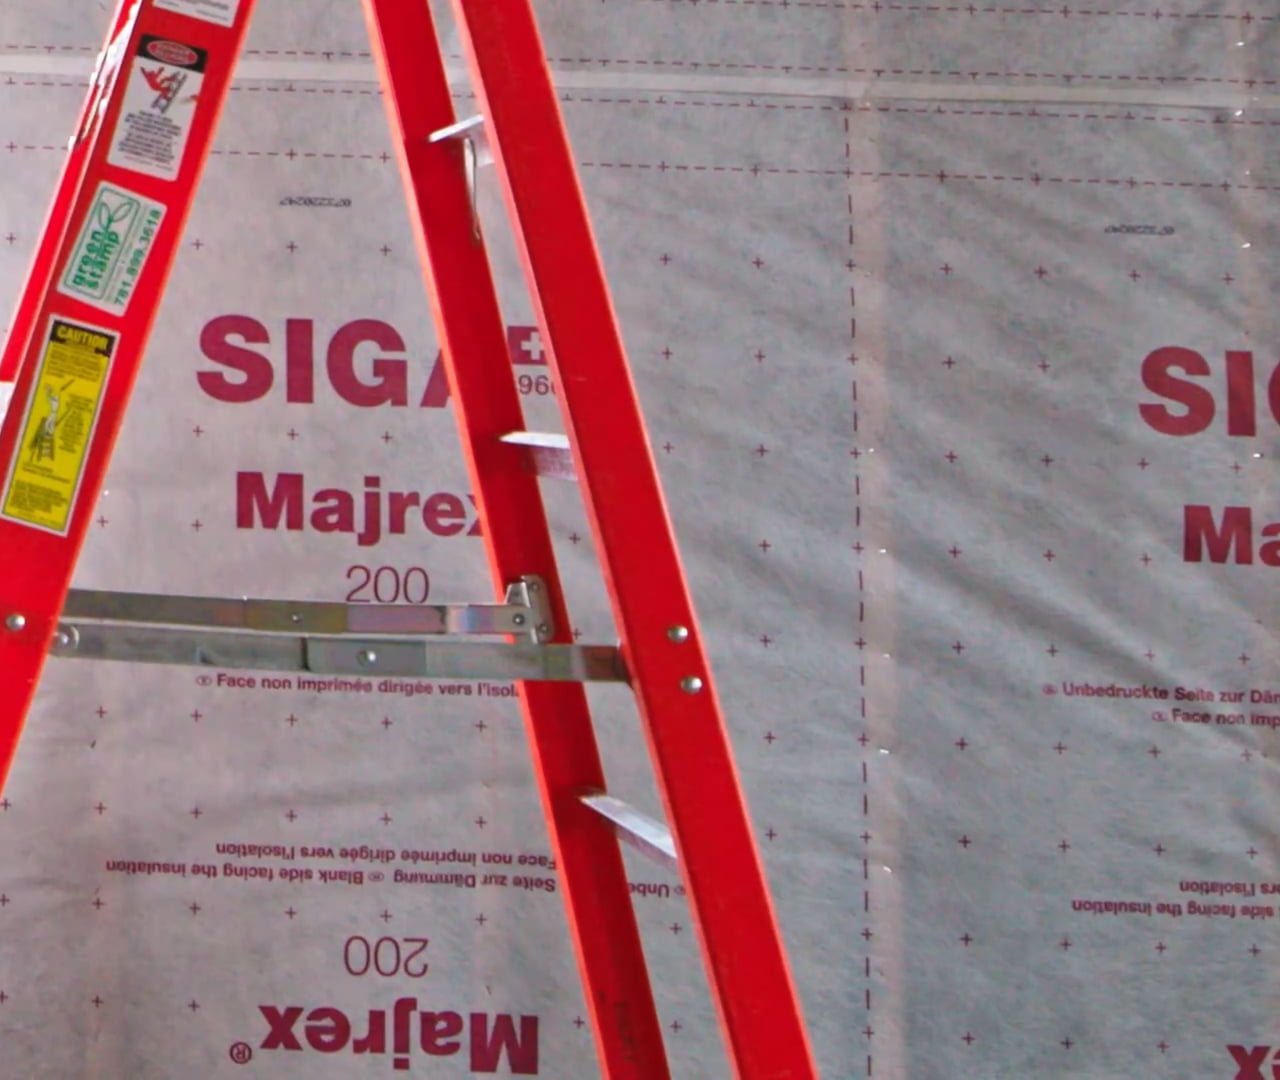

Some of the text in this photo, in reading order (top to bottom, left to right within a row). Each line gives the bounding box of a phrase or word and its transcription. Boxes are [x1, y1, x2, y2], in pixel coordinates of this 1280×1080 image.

[56, 325, 108, 348] CAUTION
[1138, 346, 1280, 437] SI
[345, 565, 429, 604] 200
[217, 675, 256, 689] Face
[261, 678, 293, 690] non
[438, 683, 473, 695] vers
[1063, 682, 1245, 703] Unbedruckte Seite zur
[1171, 708, 1245, 725] Face non
[216, 842, 295, 861] l'isolation
[300, 846, 334, 859] vers
[339, 845, 396, 863] dirigée
[401, 849, 477, 868] imprimée
[481, 853, 513, 865] non
[106, 859, 555, 892] Seite zur Dämmung Blank side facing the insulation
[1071, 900, 1274, 920] side facing the insulation
[343, 936, 429, 978] 200
